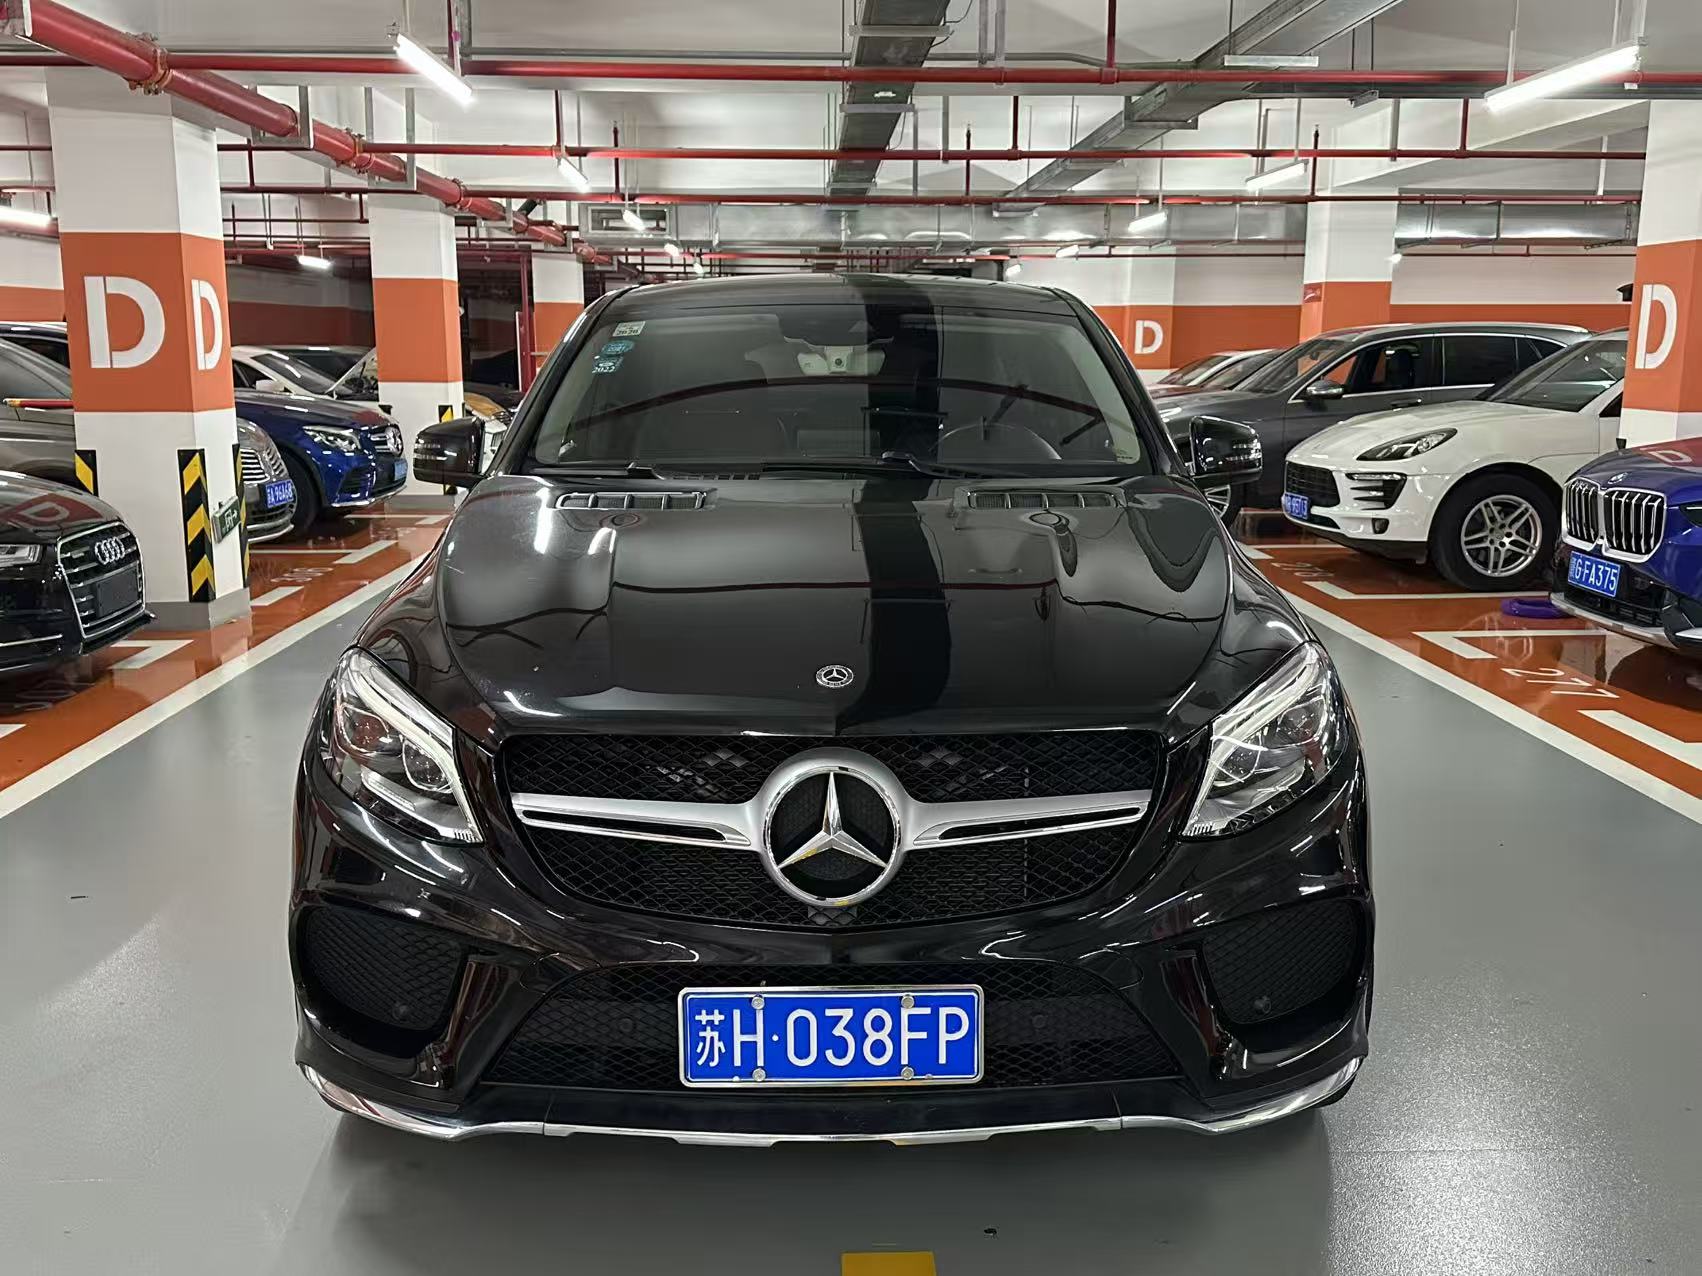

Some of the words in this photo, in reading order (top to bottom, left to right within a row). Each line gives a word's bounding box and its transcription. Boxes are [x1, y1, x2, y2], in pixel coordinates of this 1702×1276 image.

[84, 276, 165, 369] D
[191, 279, 223, 370] D
[1134, 320, 1163, 355] D
[1635, 284, 1678, 370] D
[1500, 667, 1620, 699] 277
[694, 1006, 970, 1068] 苏H·038FP
